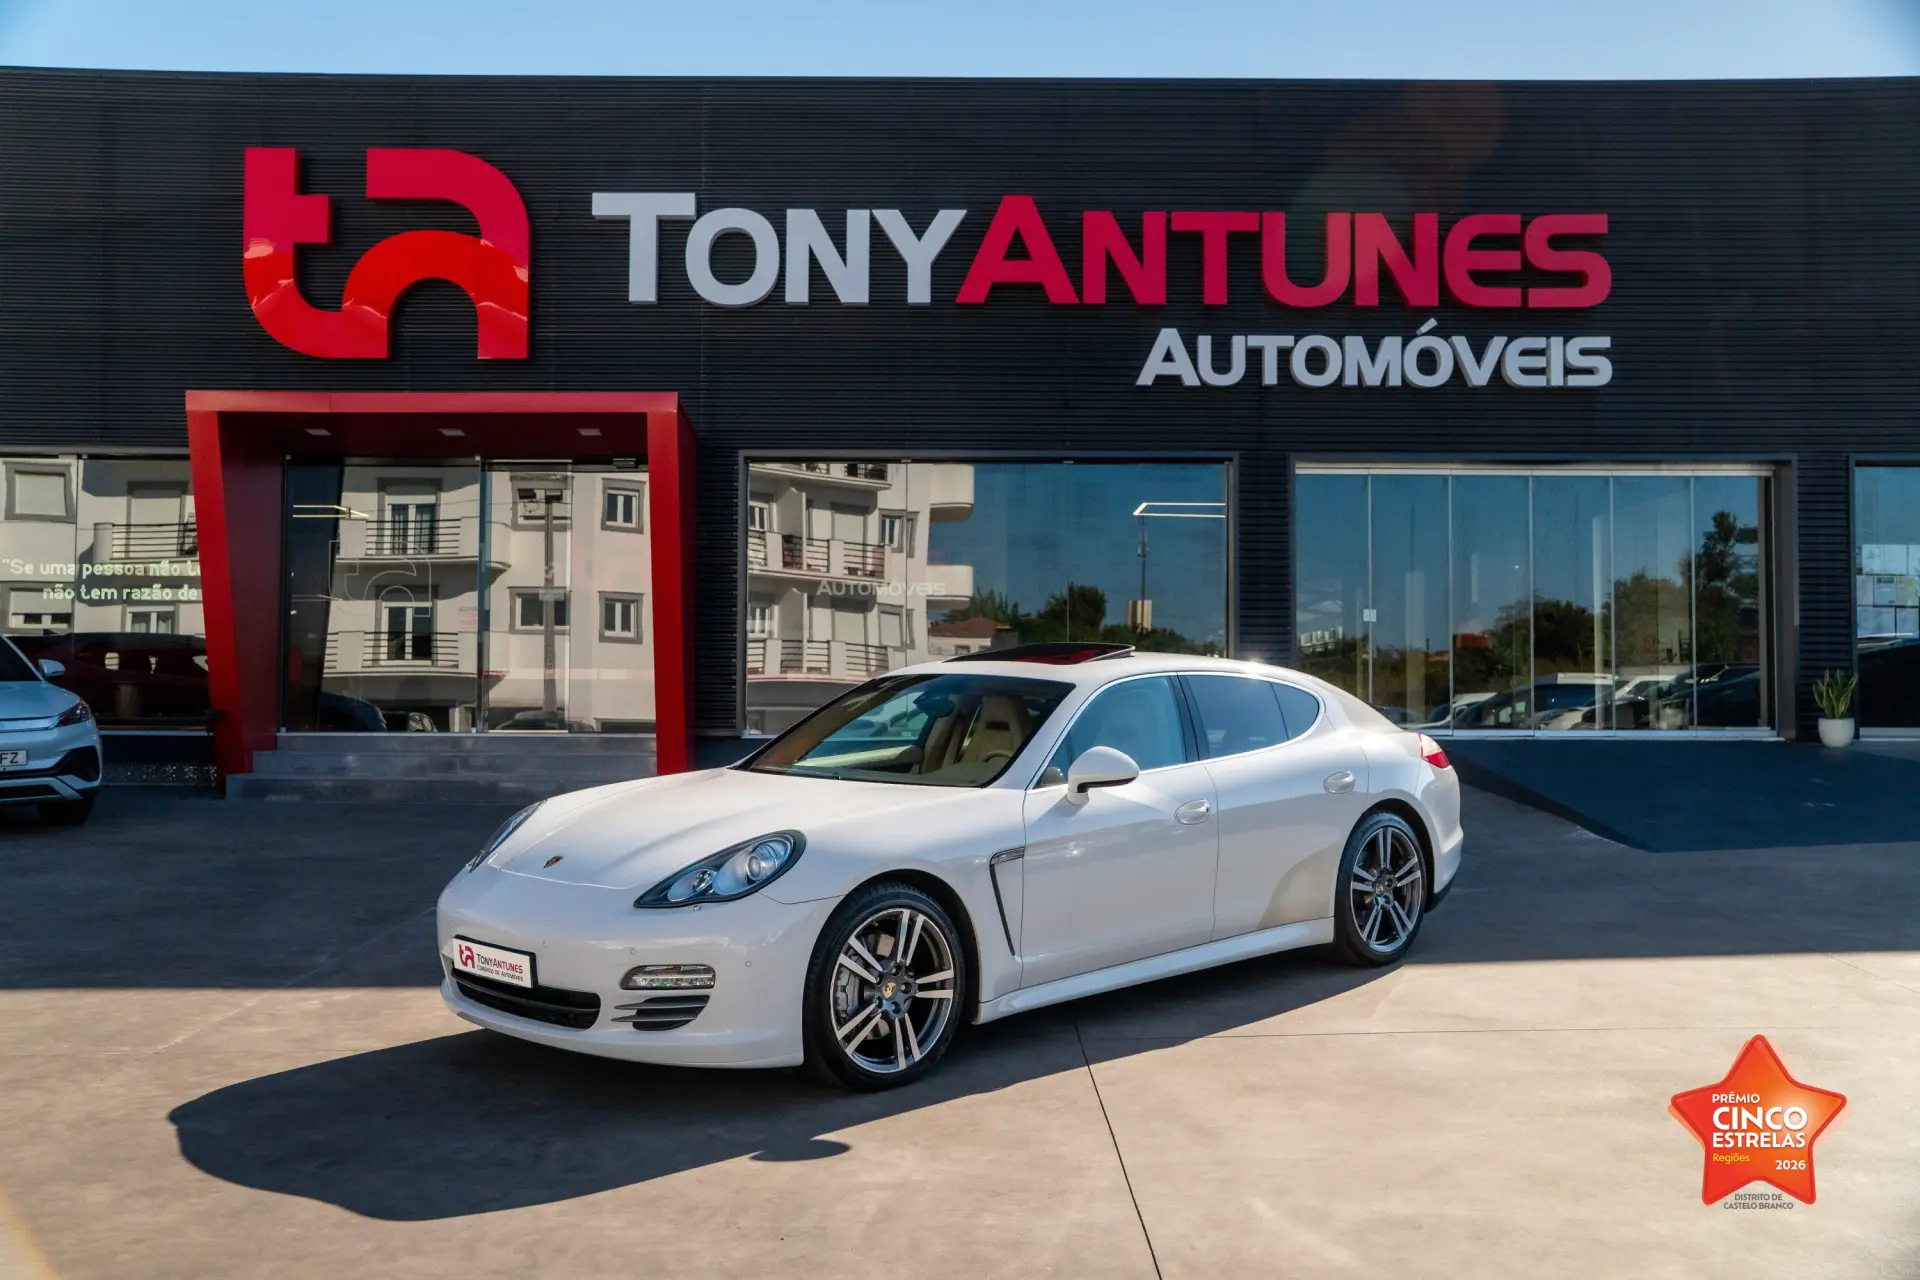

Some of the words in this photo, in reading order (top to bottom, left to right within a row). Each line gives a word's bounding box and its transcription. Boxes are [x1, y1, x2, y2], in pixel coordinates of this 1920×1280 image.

[1135, 317, 1614, 389] AUTOMÓVEIS
[40, 563, 75, 576] uma
[82, 562, 145, 579] pessoa
[150, 560, 181, 577] não
[42, 583, 75, 600] não
[80, 584, 118, 600] tem
[123, 583, 173, 600] razão
